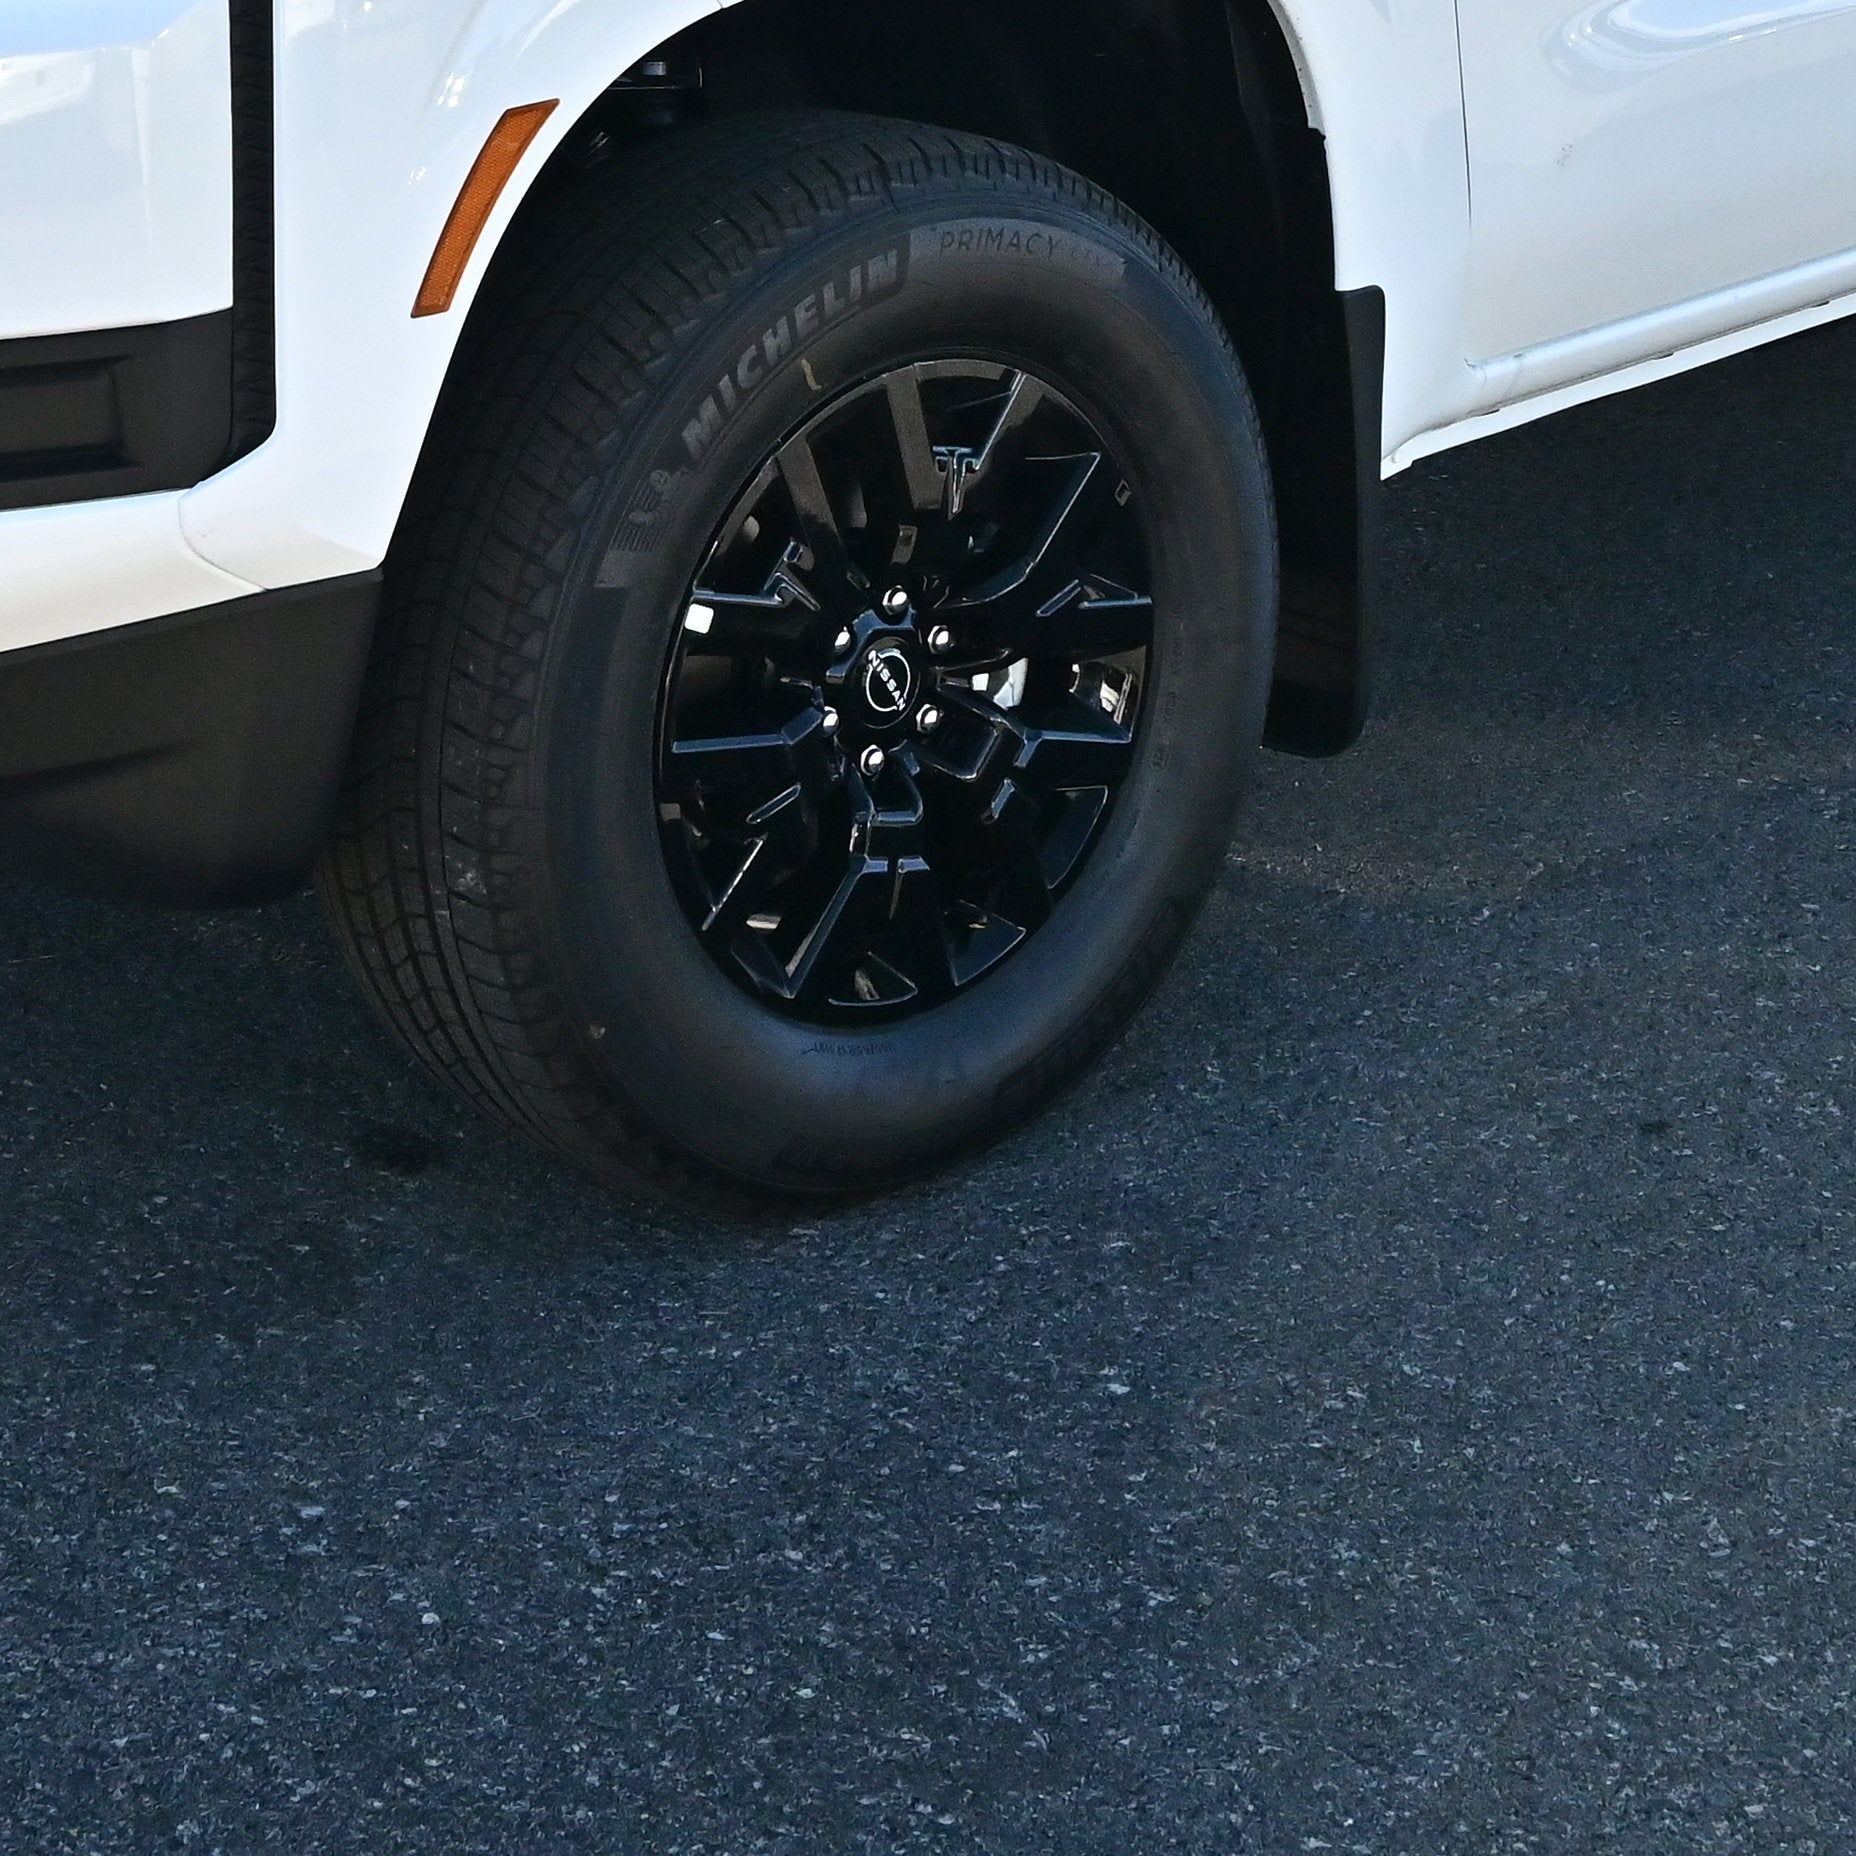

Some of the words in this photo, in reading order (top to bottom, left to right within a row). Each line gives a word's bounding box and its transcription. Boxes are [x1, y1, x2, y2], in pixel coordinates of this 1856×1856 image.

[941, 228, 1062, 261] PRIMACY
[681, 248, 900, 462] MICHELIN
[867, 649, 906, 712] NISSAN
